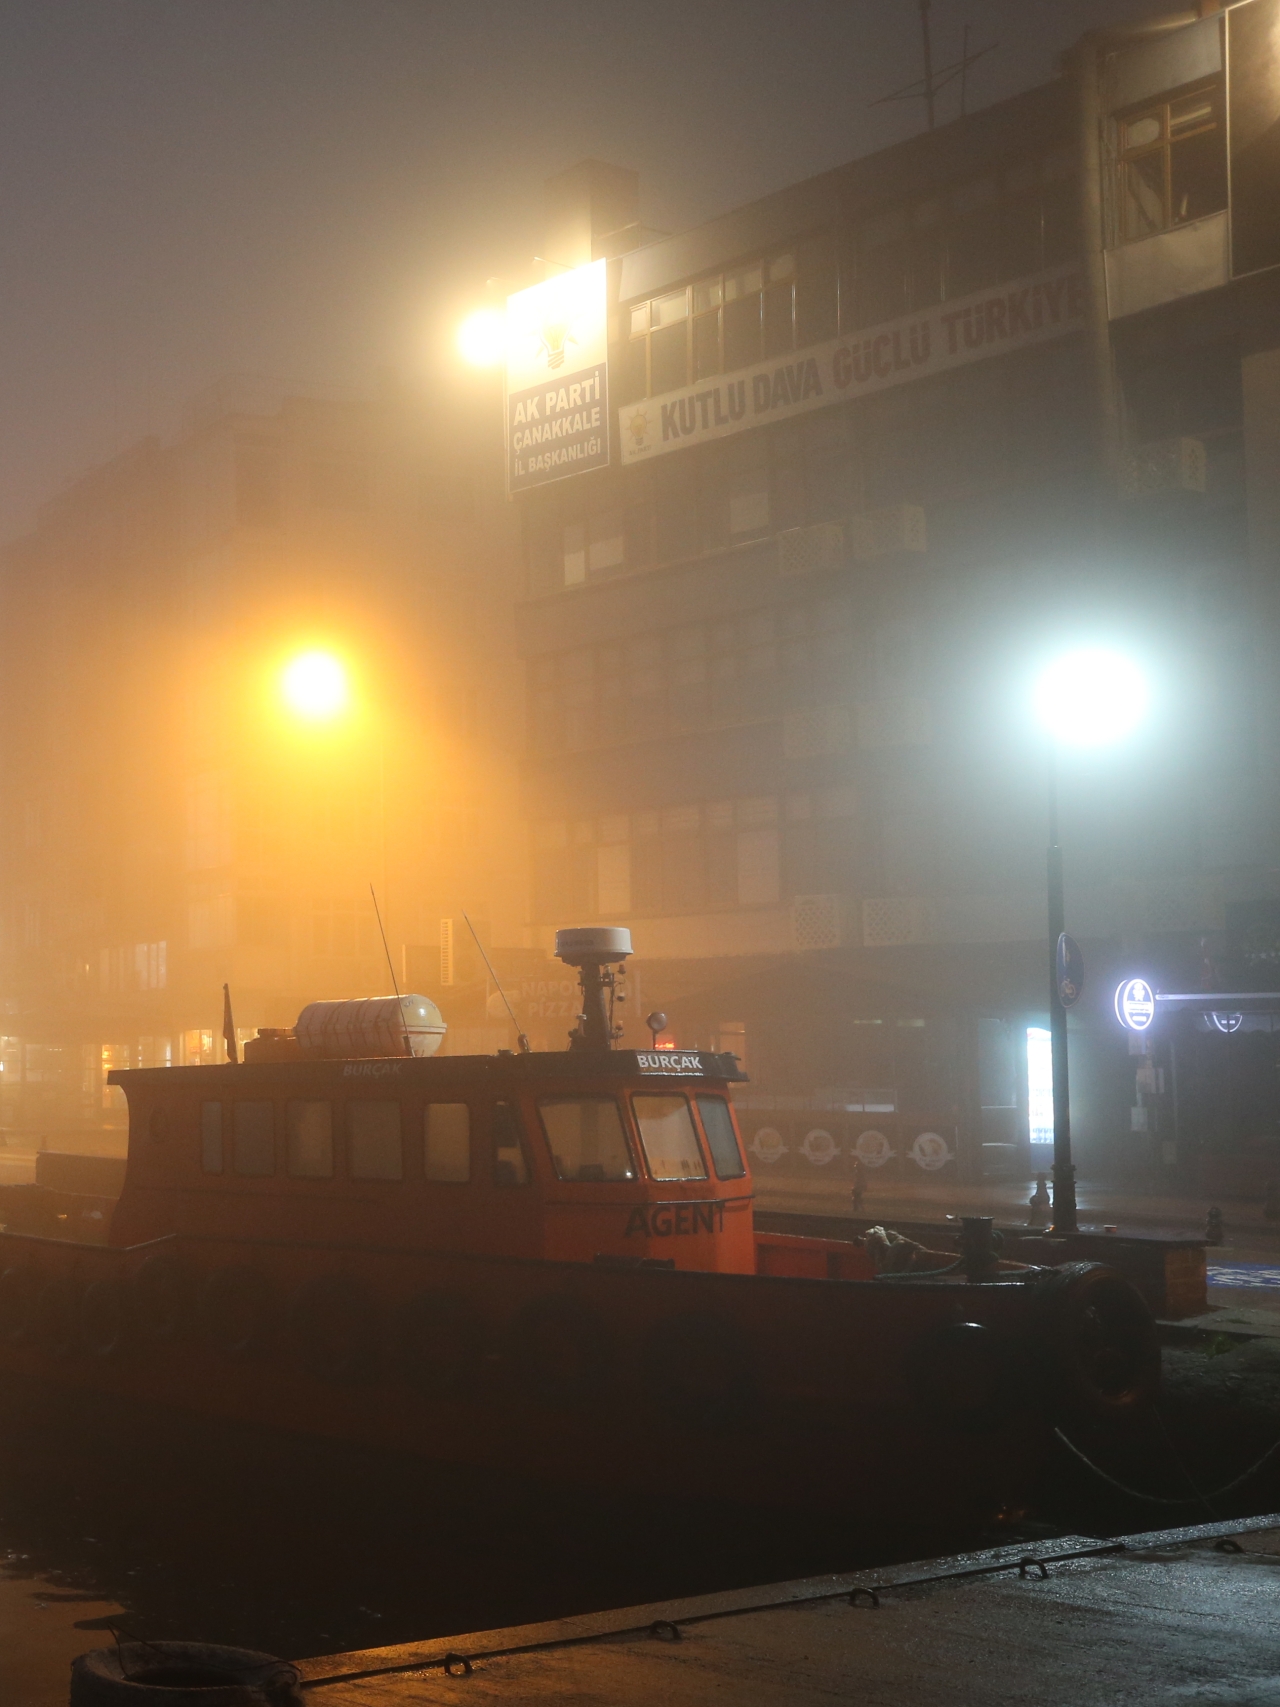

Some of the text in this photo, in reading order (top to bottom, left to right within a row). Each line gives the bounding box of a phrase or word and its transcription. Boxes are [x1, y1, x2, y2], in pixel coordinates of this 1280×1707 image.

[513, 370, 600, 426] AK PARTİ
[661, 380, 746, 442] KUTLU
[752, 357, 824, 415] DAVA
[513, 407, 601, 455] ÇANAKKALE
[514, 436, 601, 477] İL BAŞKANLIĞI
[343, 1062, 403, 1080] BURÇAK
[637, 1055, 703, 1072] BURÇAK
[623, 1203, 726, 1238] AGENT
